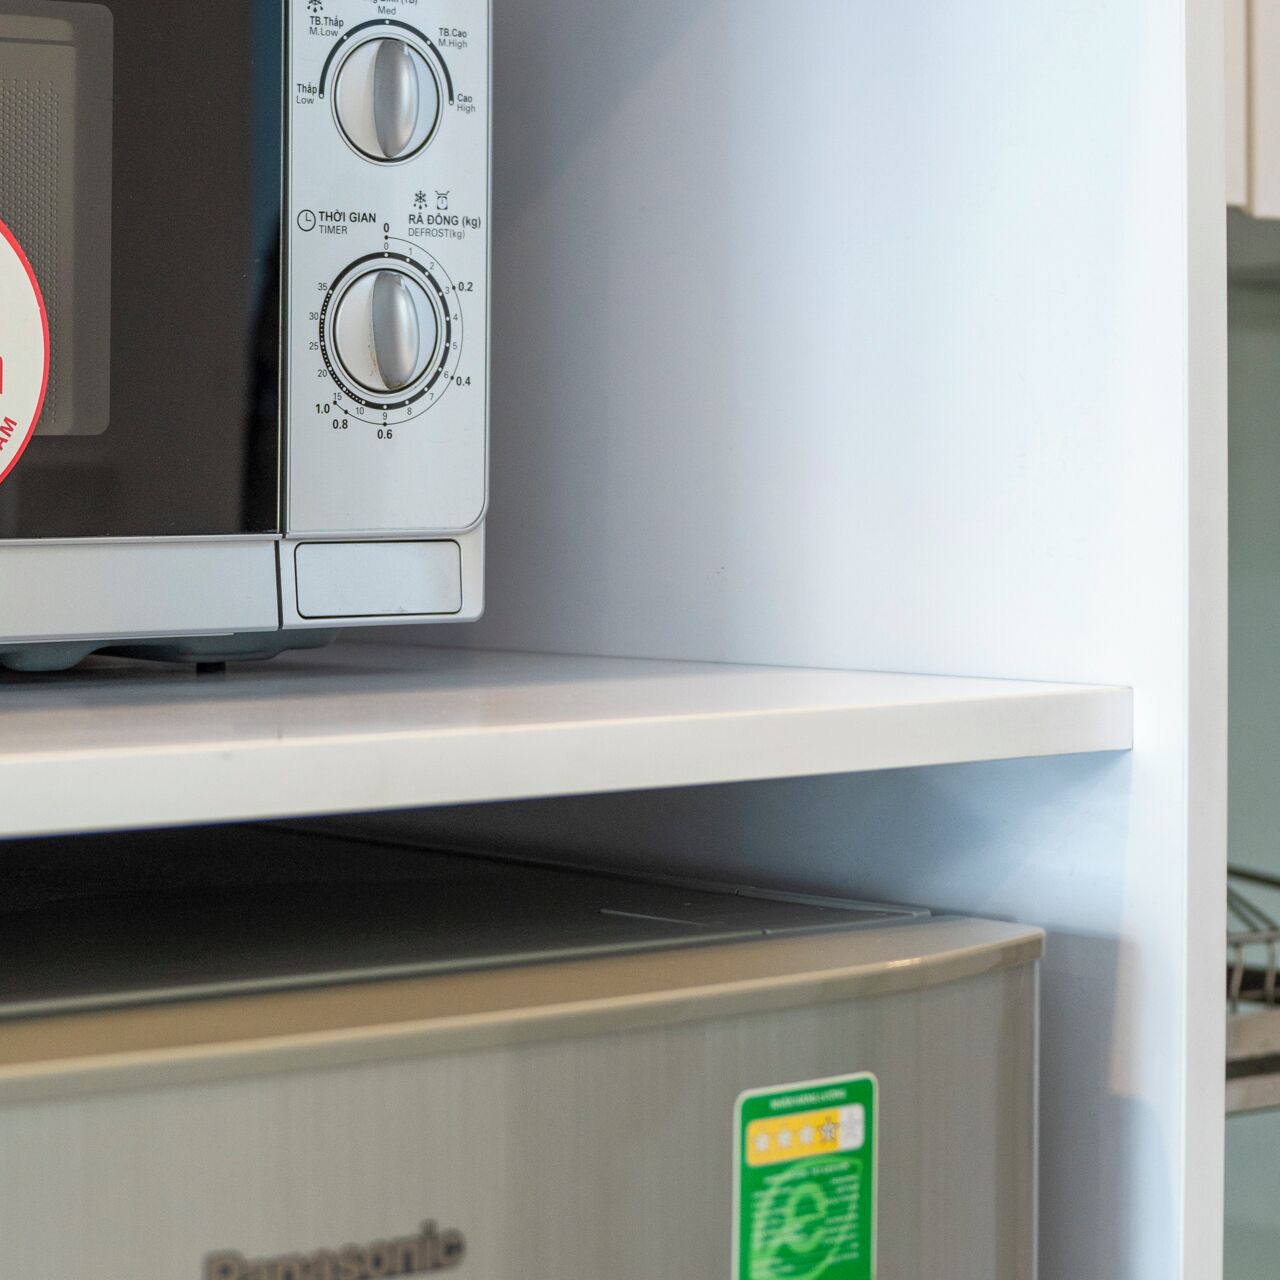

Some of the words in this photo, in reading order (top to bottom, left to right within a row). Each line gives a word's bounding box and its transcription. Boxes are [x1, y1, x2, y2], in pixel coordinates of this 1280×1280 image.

[377, 5, 397, 15] Med
[309, 27, 338, 36] M.Low
[438, 27, 468, 38] TB.Cao
[438, 39, 468, 49] M.High
[296, 95, 315, 105] Low
[457, 93, 473, 103] Cao
[457, 104, 476, 113] High
[349, 212, 376, 223] GIAN
[426, 213, 459, 226] ĐÔNG
[461, 215, 481, 229] (kg)
[319, 225, 348, 235] TIMER
[383, 223, 389, 233] 0
[383, 242, 389, 250] 0
[429, 262, 434, 270] 2
[318, 283, 327, 291] 35
[445, 286, 450, 295] 3
[458, 282, 473, 292] 0.2
[309, 312, 319, 321] 30
[453, 313, 458, 321] 4
[309, 342, 319, 350] 25
[453, 342, 458, 350] 5
[318, 369, 327, 378] 20
[444, 371, 449, 379] 6
[456, 376, 471, 386] 0.4
[333, 392, 342, 401] 15
[430, 393, 434, 401] 7
[315, 404, 330, 414] 1.0
[356, 407, 364, 415] 10
[407, 407, 412, 415] 8
[383, 412, 388, 420] 9
[332, 419, 348, 430] 0.8
[377, 429, 393, 439] 0.6
